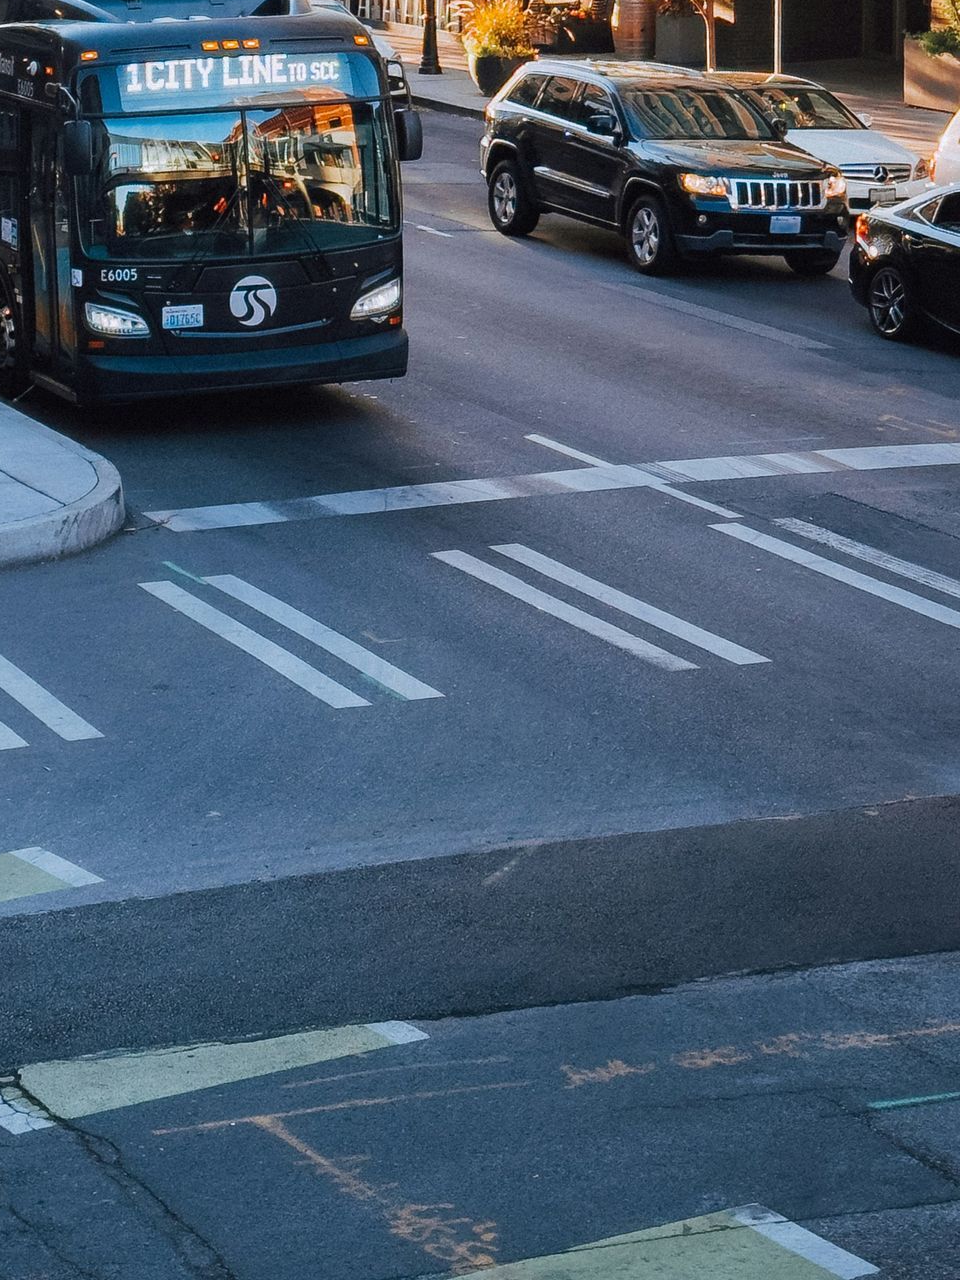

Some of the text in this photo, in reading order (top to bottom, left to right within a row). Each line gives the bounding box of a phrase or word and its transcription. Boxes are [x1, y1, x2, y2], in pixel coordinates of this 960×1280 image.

[126, 53, 339, 93] 1 CITY LINE TO SCC
[772, 171, 789, 179] Jeep
[100, 268, 138, 282] E6005
